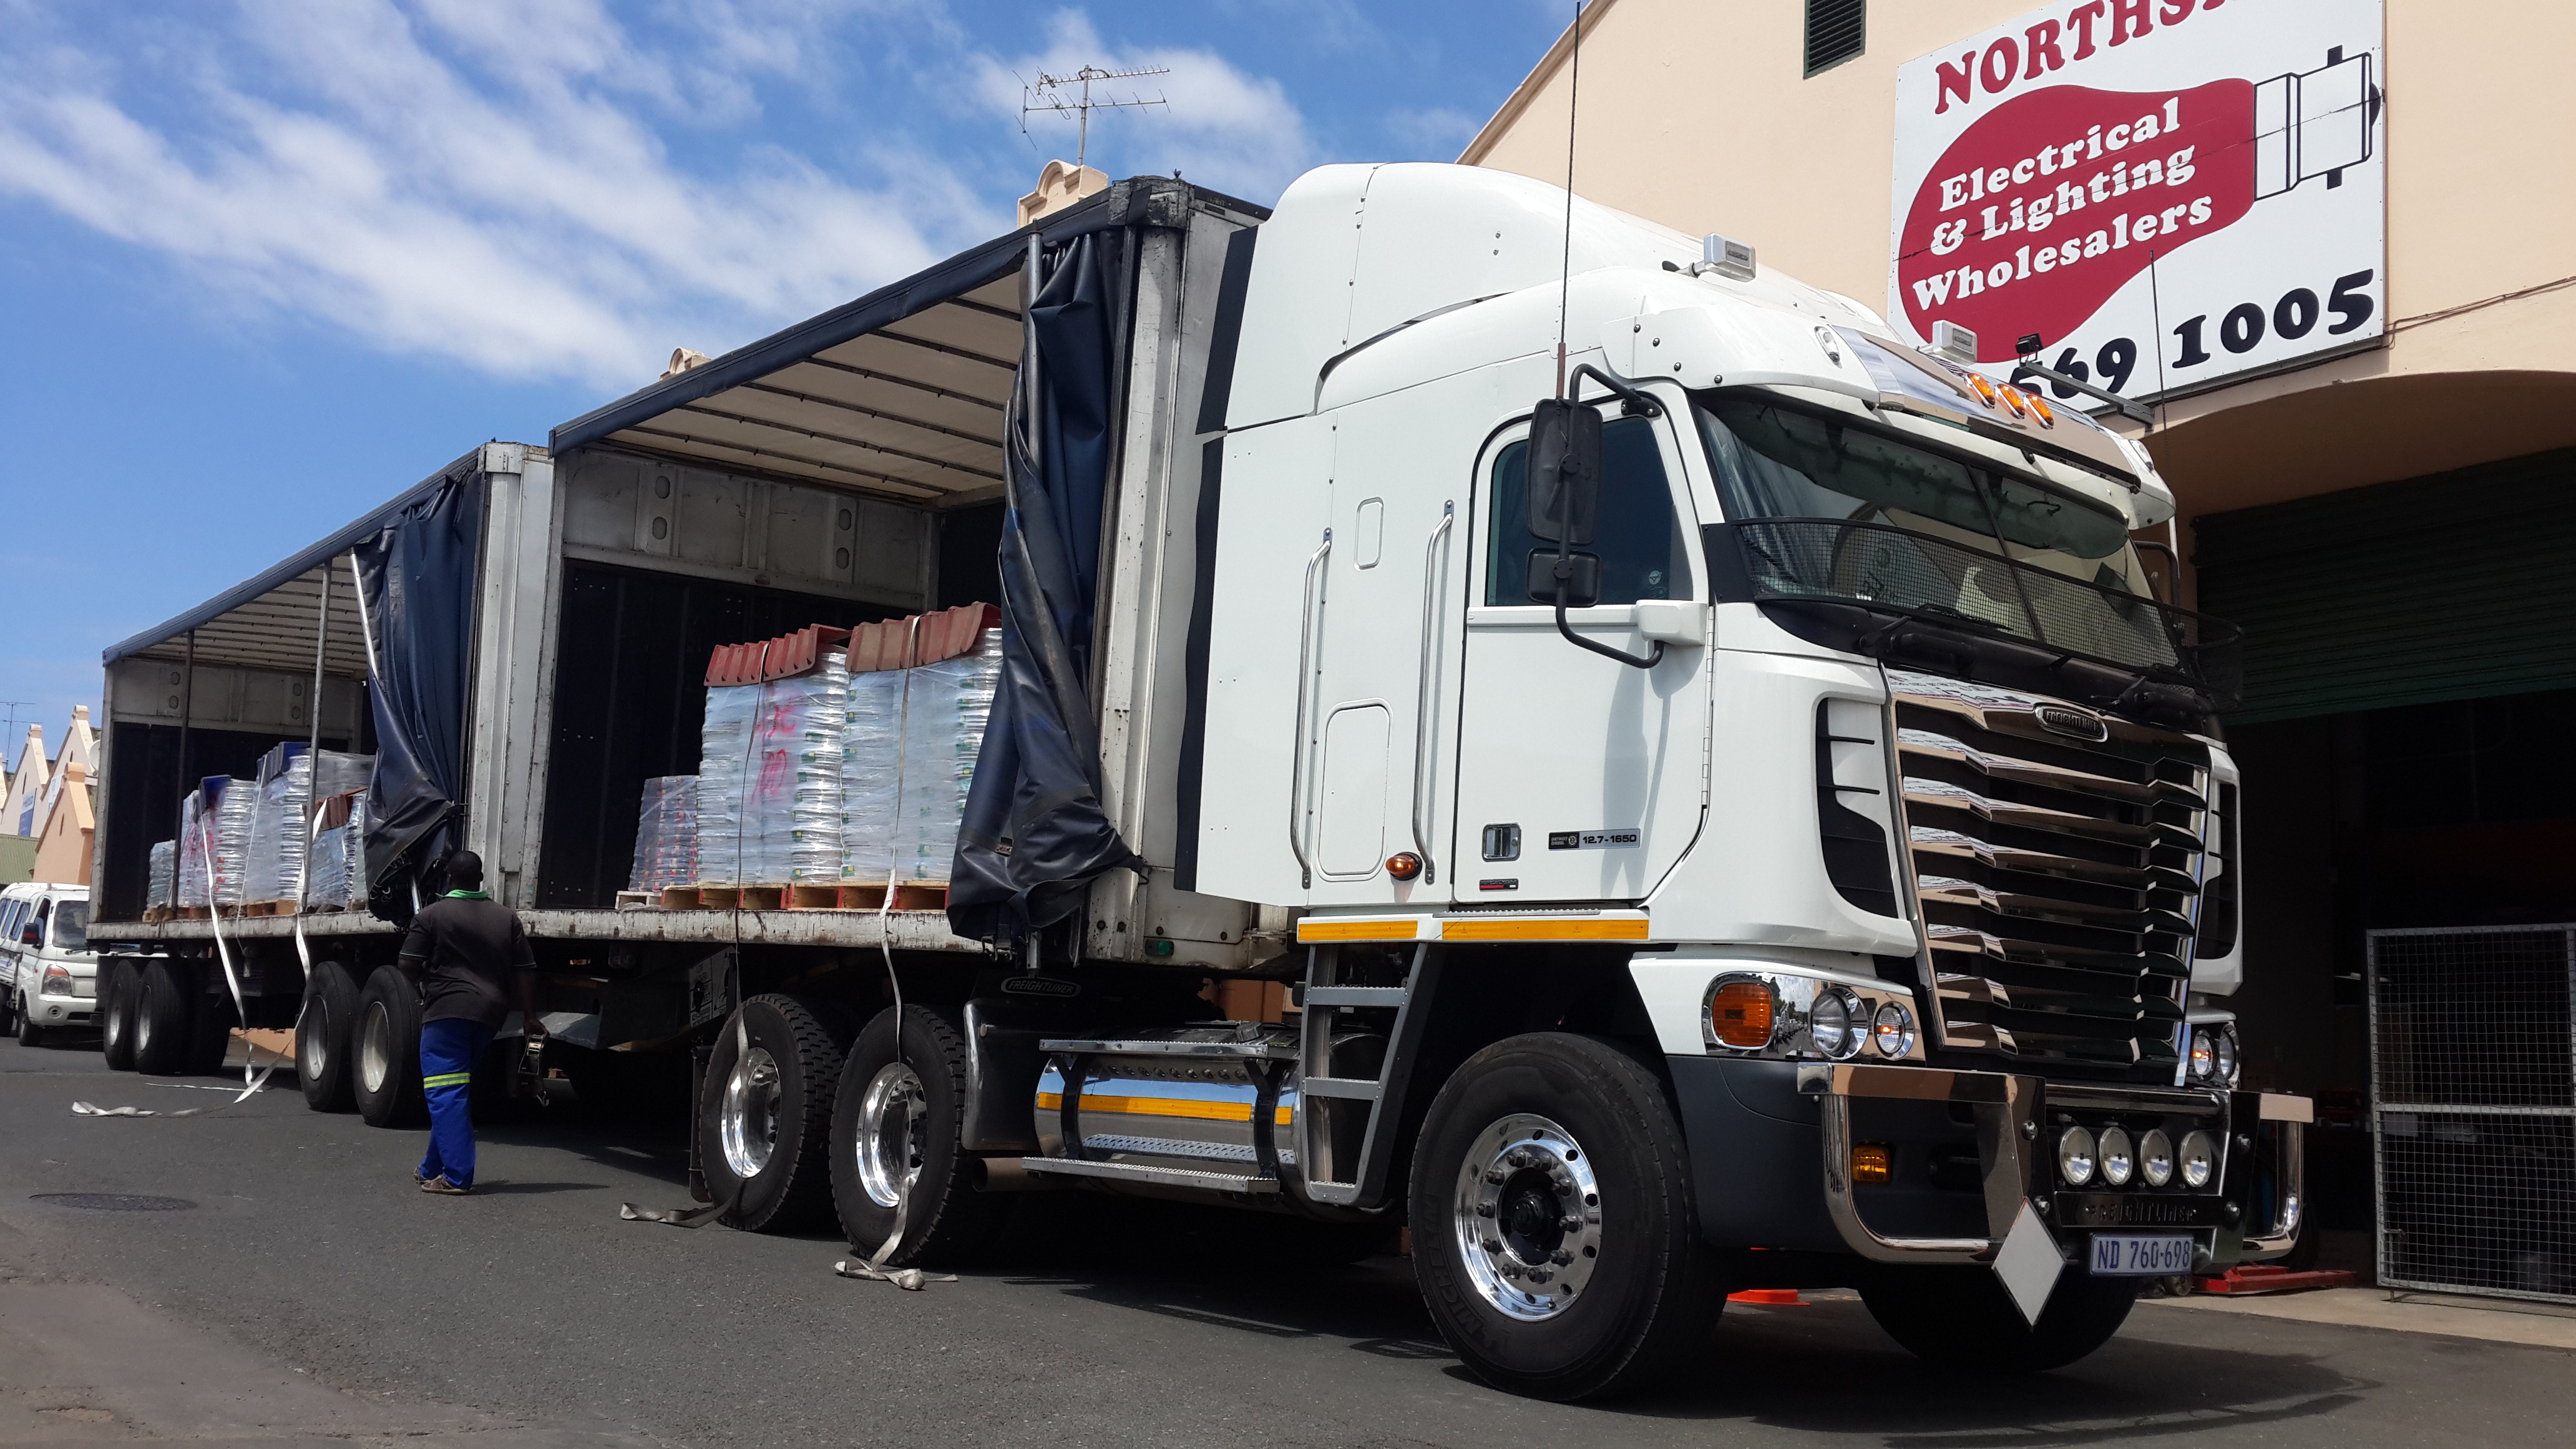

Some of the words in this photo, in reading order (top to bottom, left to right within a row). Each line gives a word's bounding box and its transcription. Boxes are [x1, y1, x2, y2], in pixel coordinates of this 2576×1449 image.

[1935, 0, 2225, 114] NORTHS
[1930, 218, 1968, 256] &
[1981, 145, 2195, 241] Lighting
[1939, 97, 2180, 212] Electrical
[1912, 195, 2213, 311] Wholesalers
[2172, 268, 2374, 369] 1005
[1583, 834, 1637, 844] 12.7-1650
[1007, 980, 1075, 993] FREIGHTLINER
[2097, 1241, 2120, 1269] ND
